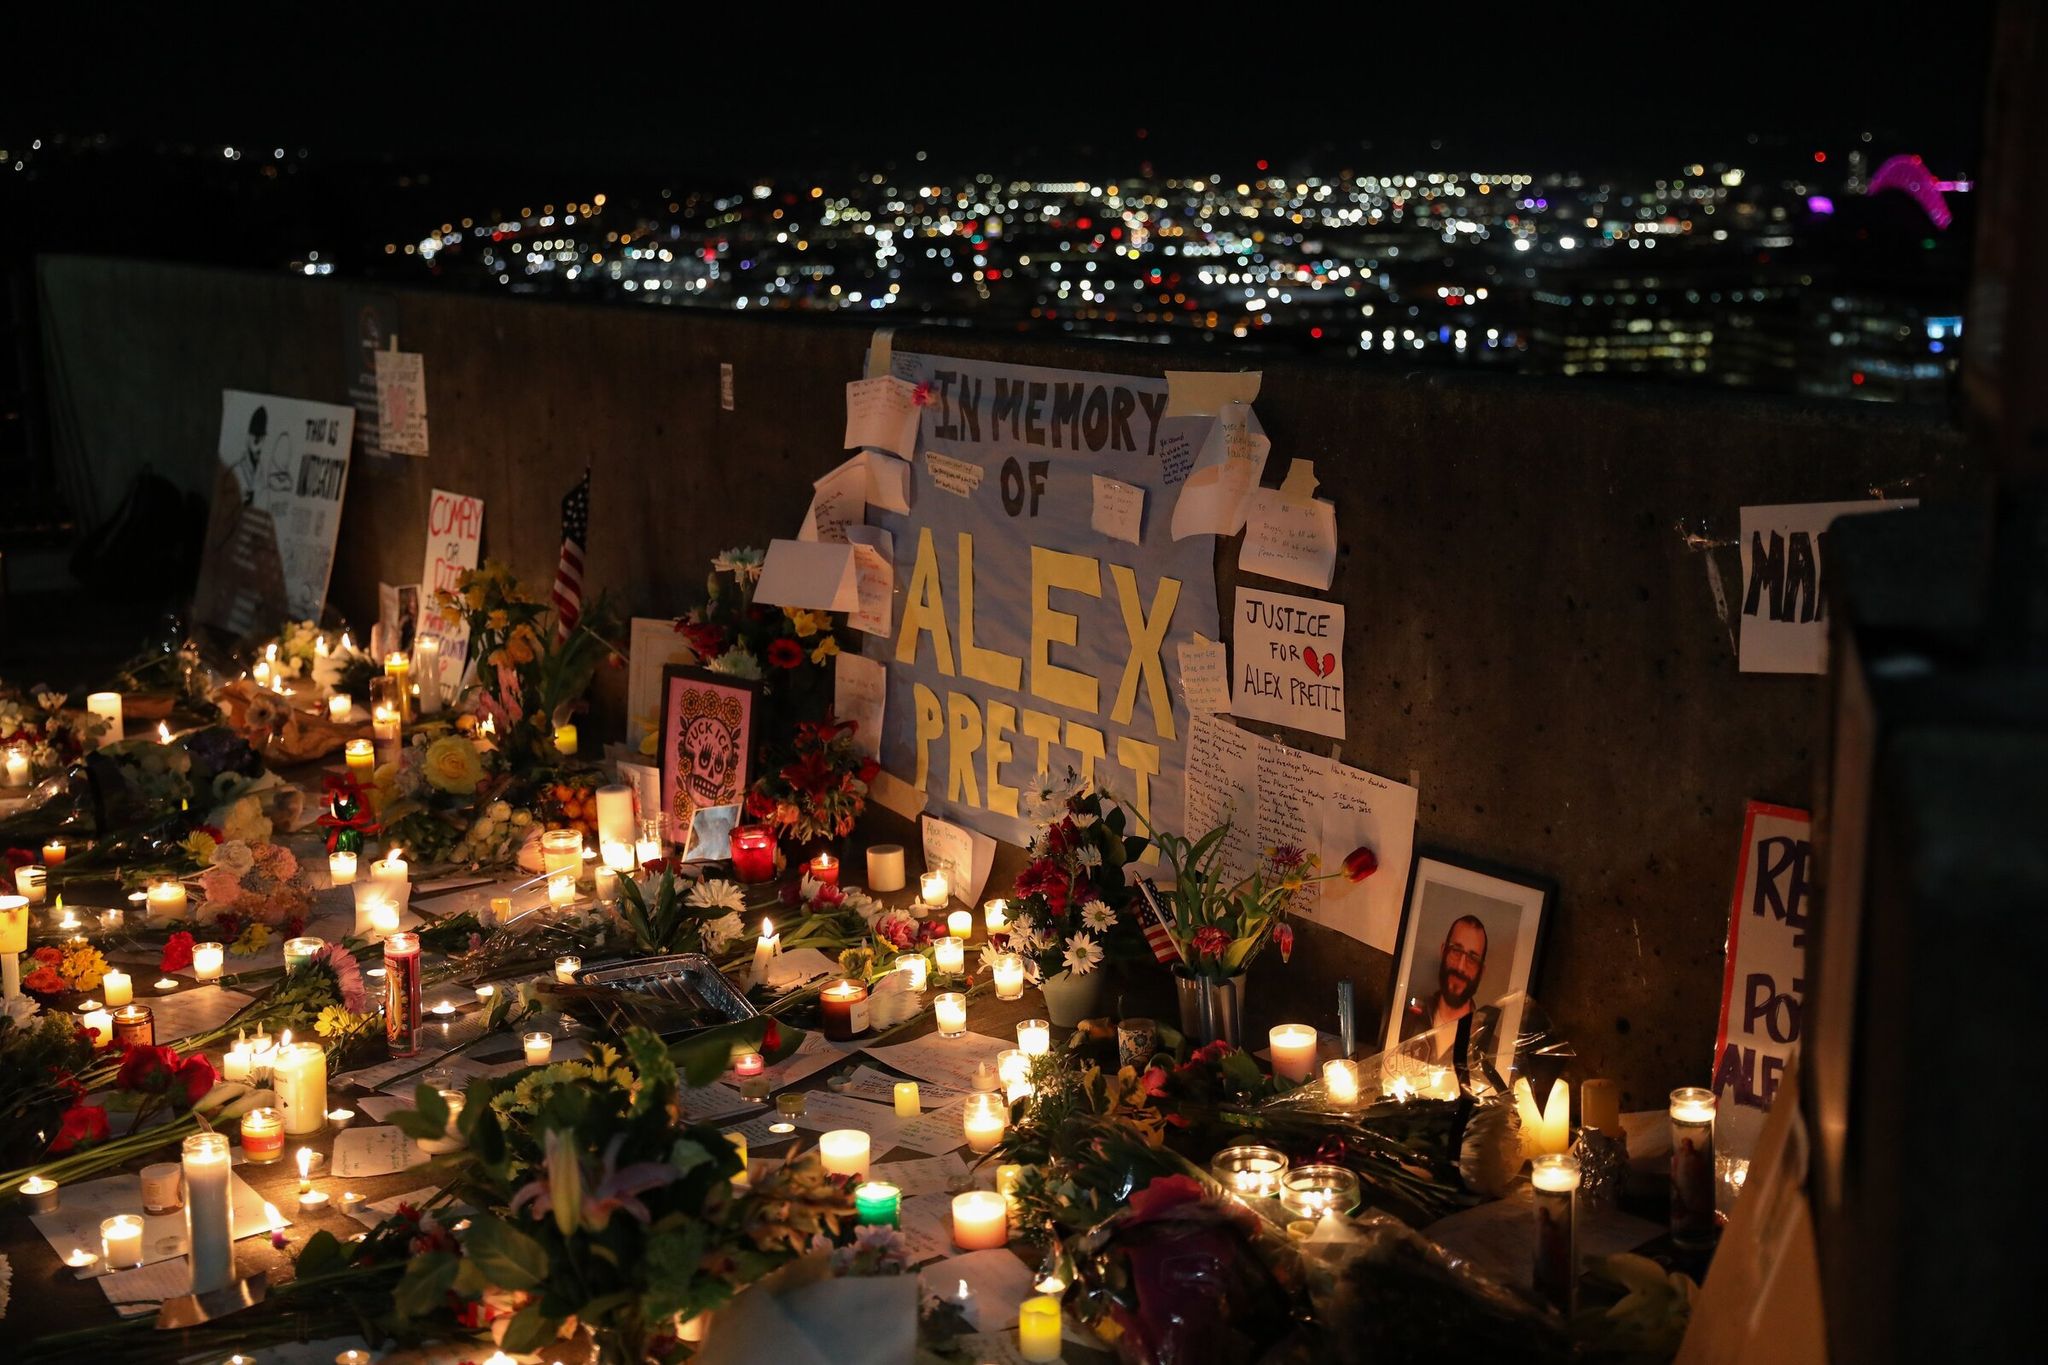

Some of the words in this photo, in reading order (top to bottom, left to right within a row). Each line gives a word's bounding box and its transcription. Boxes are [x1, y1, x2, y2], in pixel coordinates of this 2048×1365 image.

[934, 369, 982, 442] IN
[992, 376, 1169, 456] MEMORY
[1000, 456, 1050, 518] OF
[1743, 529, 1826, 624] MA
[895, 526, 1183, 741] ALEX
[1246, 600, 1331, 637] JUSTICE
[1270, 641, 1300, 662] FOR
[1244, 664, 1282, 699] ALEX
[1290, 677, 1342, 713] PRETTI
[687, 722, 713, 749] FUCK
[715, 729, 730, 754] ICE
[1753, 835, 1813, 927] RE
[1743, 974, 1802, 1044] PO
[1713, 1043, 1783, 1113] ALE
